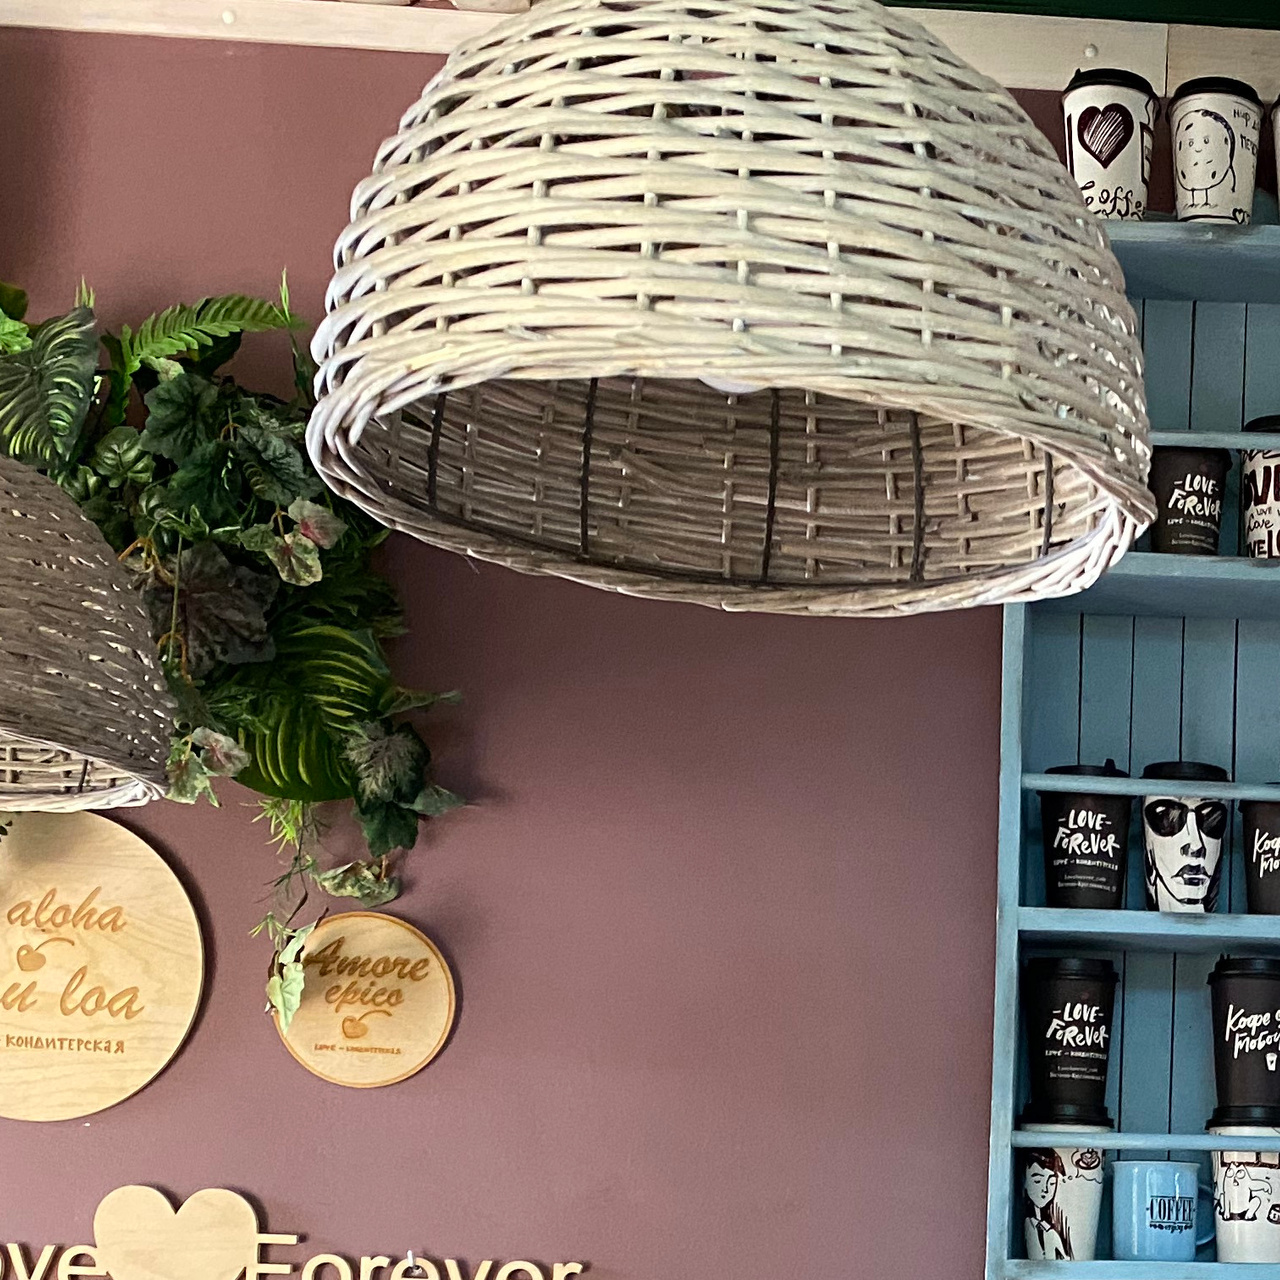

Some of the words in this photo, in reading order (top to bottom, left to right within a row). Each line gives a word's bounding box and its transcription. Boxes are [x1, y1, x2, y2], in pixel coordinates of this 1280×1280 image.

[1184, 473, 1214, 495] LOVE
[1068, 809, 1107, 830] LOVE
[7, 885, 128, 933] aloha
[303, 936, 430, 982] Amore
[60, 965, 145, 1020] loa
[325, 980, 405, 1013] epico
[1063, 1002, 1100, 1023] LOVE
[1225, 1004, 1271, 1042] Кофе
[1150, 1198, 1193, 1221] COFFEE
